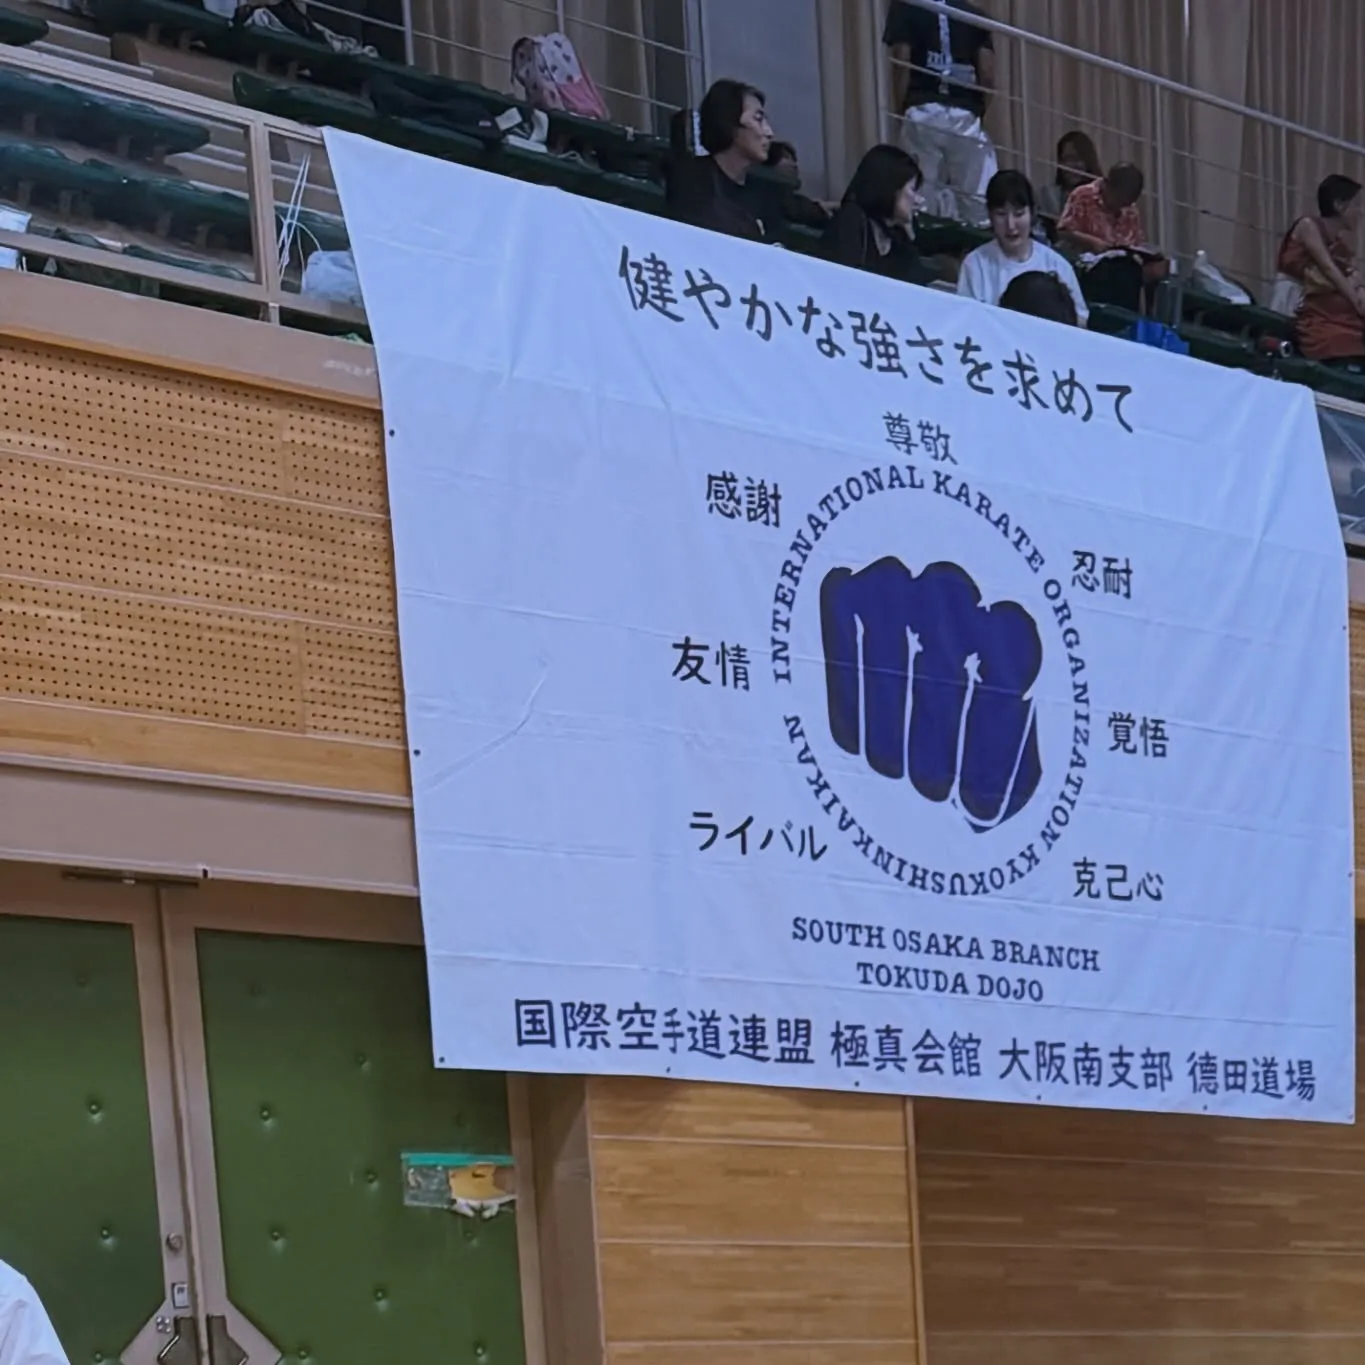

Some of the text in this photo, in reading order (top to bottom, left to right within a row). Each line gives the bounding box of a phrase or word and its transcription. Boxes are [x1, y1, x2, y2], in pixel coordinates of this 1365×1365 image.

[618, 245, 1135, 433] 健やかな強さを求めて
[883, 411, 959, 465] 尊敬
[706, 469, 782, 528] 感謝
[1071, 549, 1133, 600] 忍耐
[671, 636, 751, 692] 友情
[771, 465, 1090, 897] INTERNATIONAL KARATE ORGANIZATION KYOKUSHINKAIKAN
[1106, 711, 1169, 758] 覚悟
[688, 810, 828, 862] ライバル
[1071, 856, 1164, 902] 克己心
[791, 915, 1101, 972] SOUTH OSAKA BRANCH
[855, 961, 1044, 1003] TOKUDA DOJO
[514, 998, 1317, 1102] 国際空手道連盟 極真会館 大阪南支部 徳田道場
